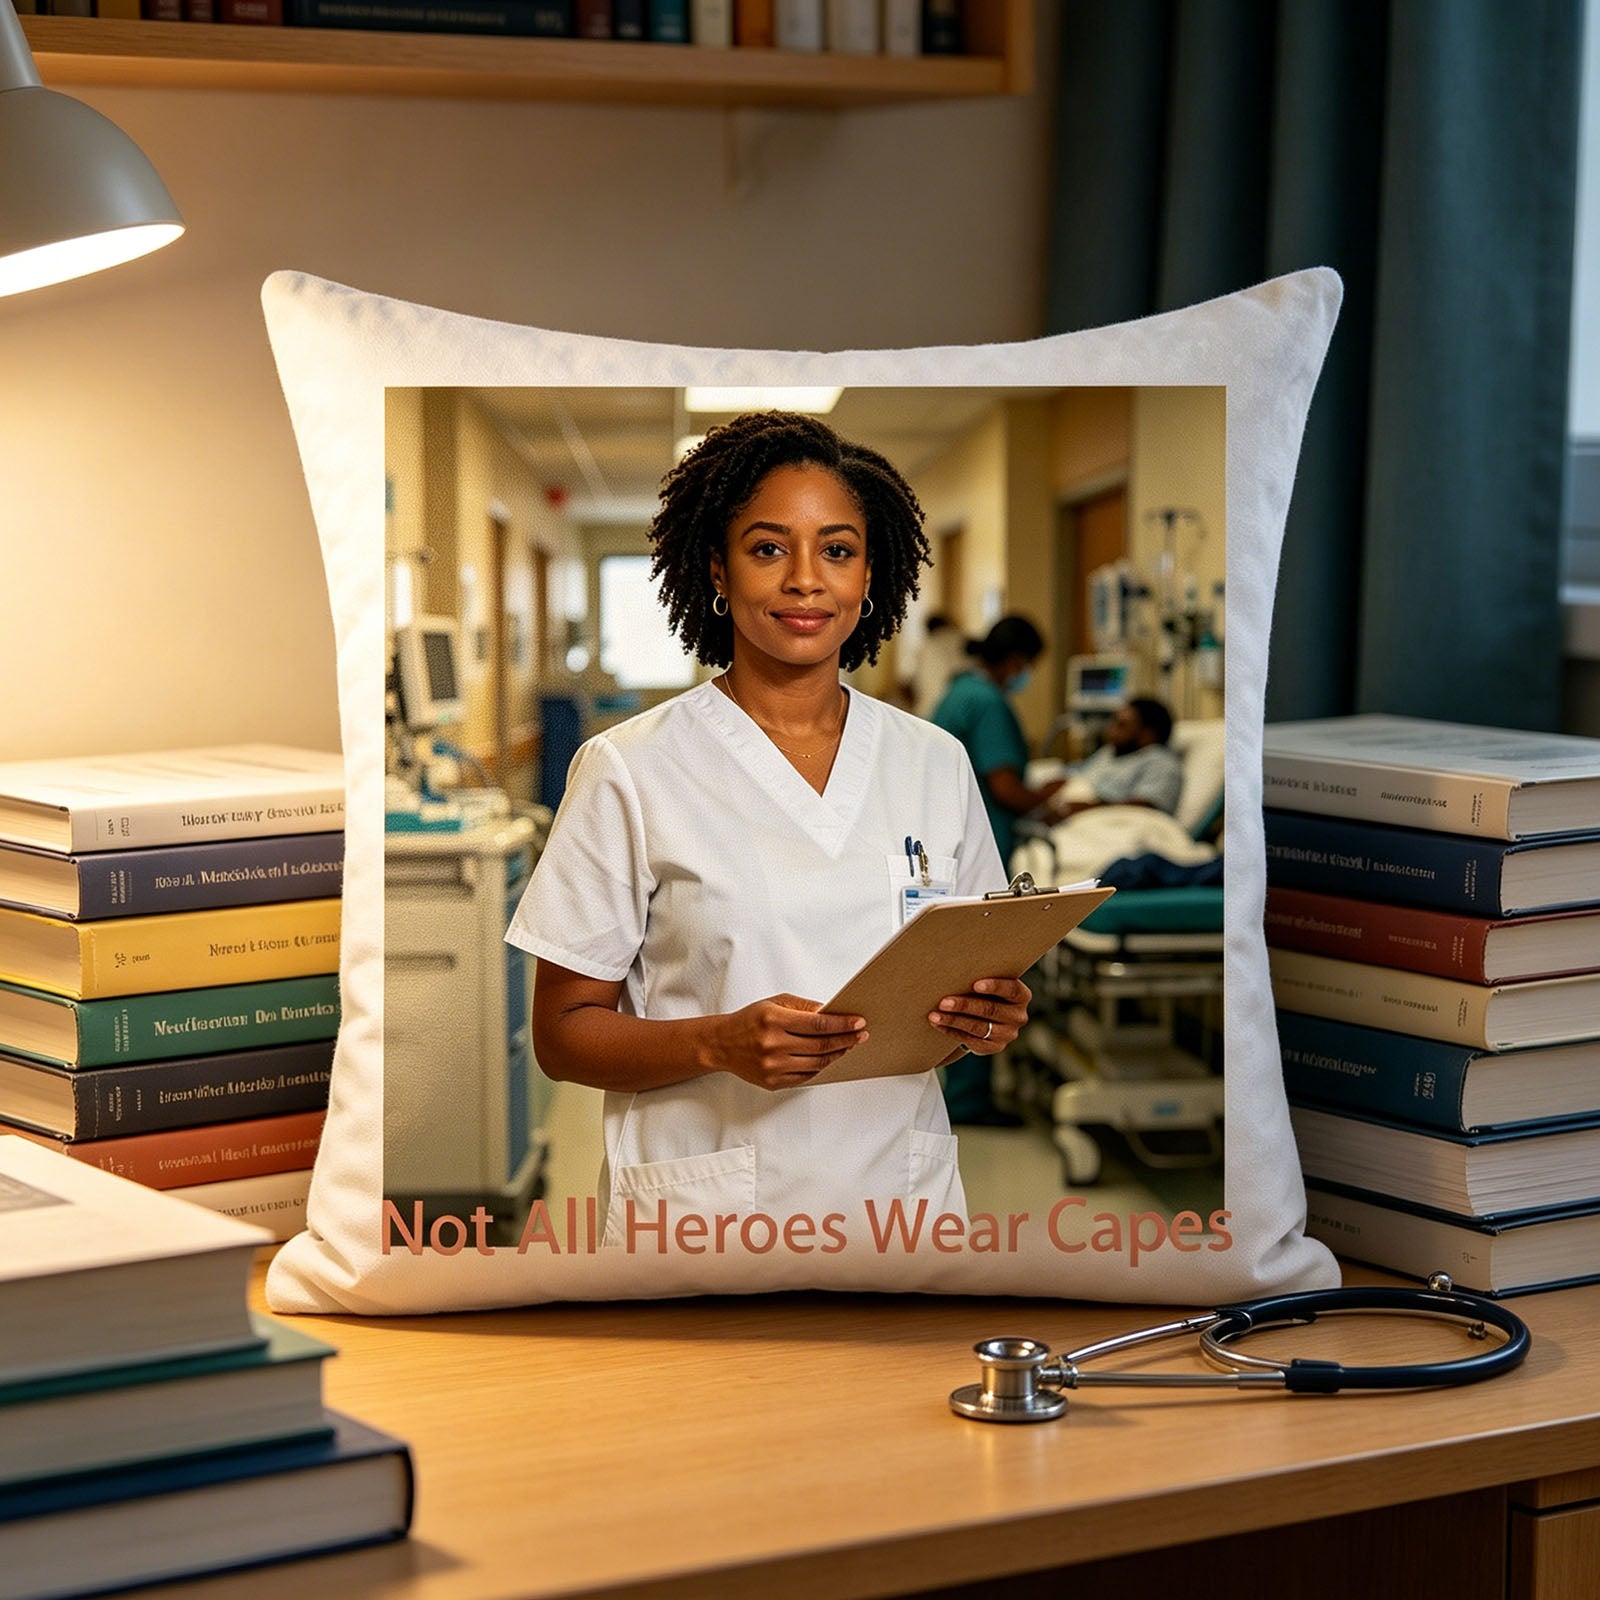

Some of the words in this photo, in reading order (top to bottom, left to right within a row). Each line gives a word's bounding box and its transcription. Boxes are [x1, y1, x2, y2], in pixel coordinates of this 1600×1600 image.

[382, 1200, 495, 1257] Not
[518, 1196, 597, 1257] All
[626, 1199, 848, 1257] Heroes
[865, 1198, 1030, 1255] Wear
[1048, 1196, 1234, 1267] Capes
